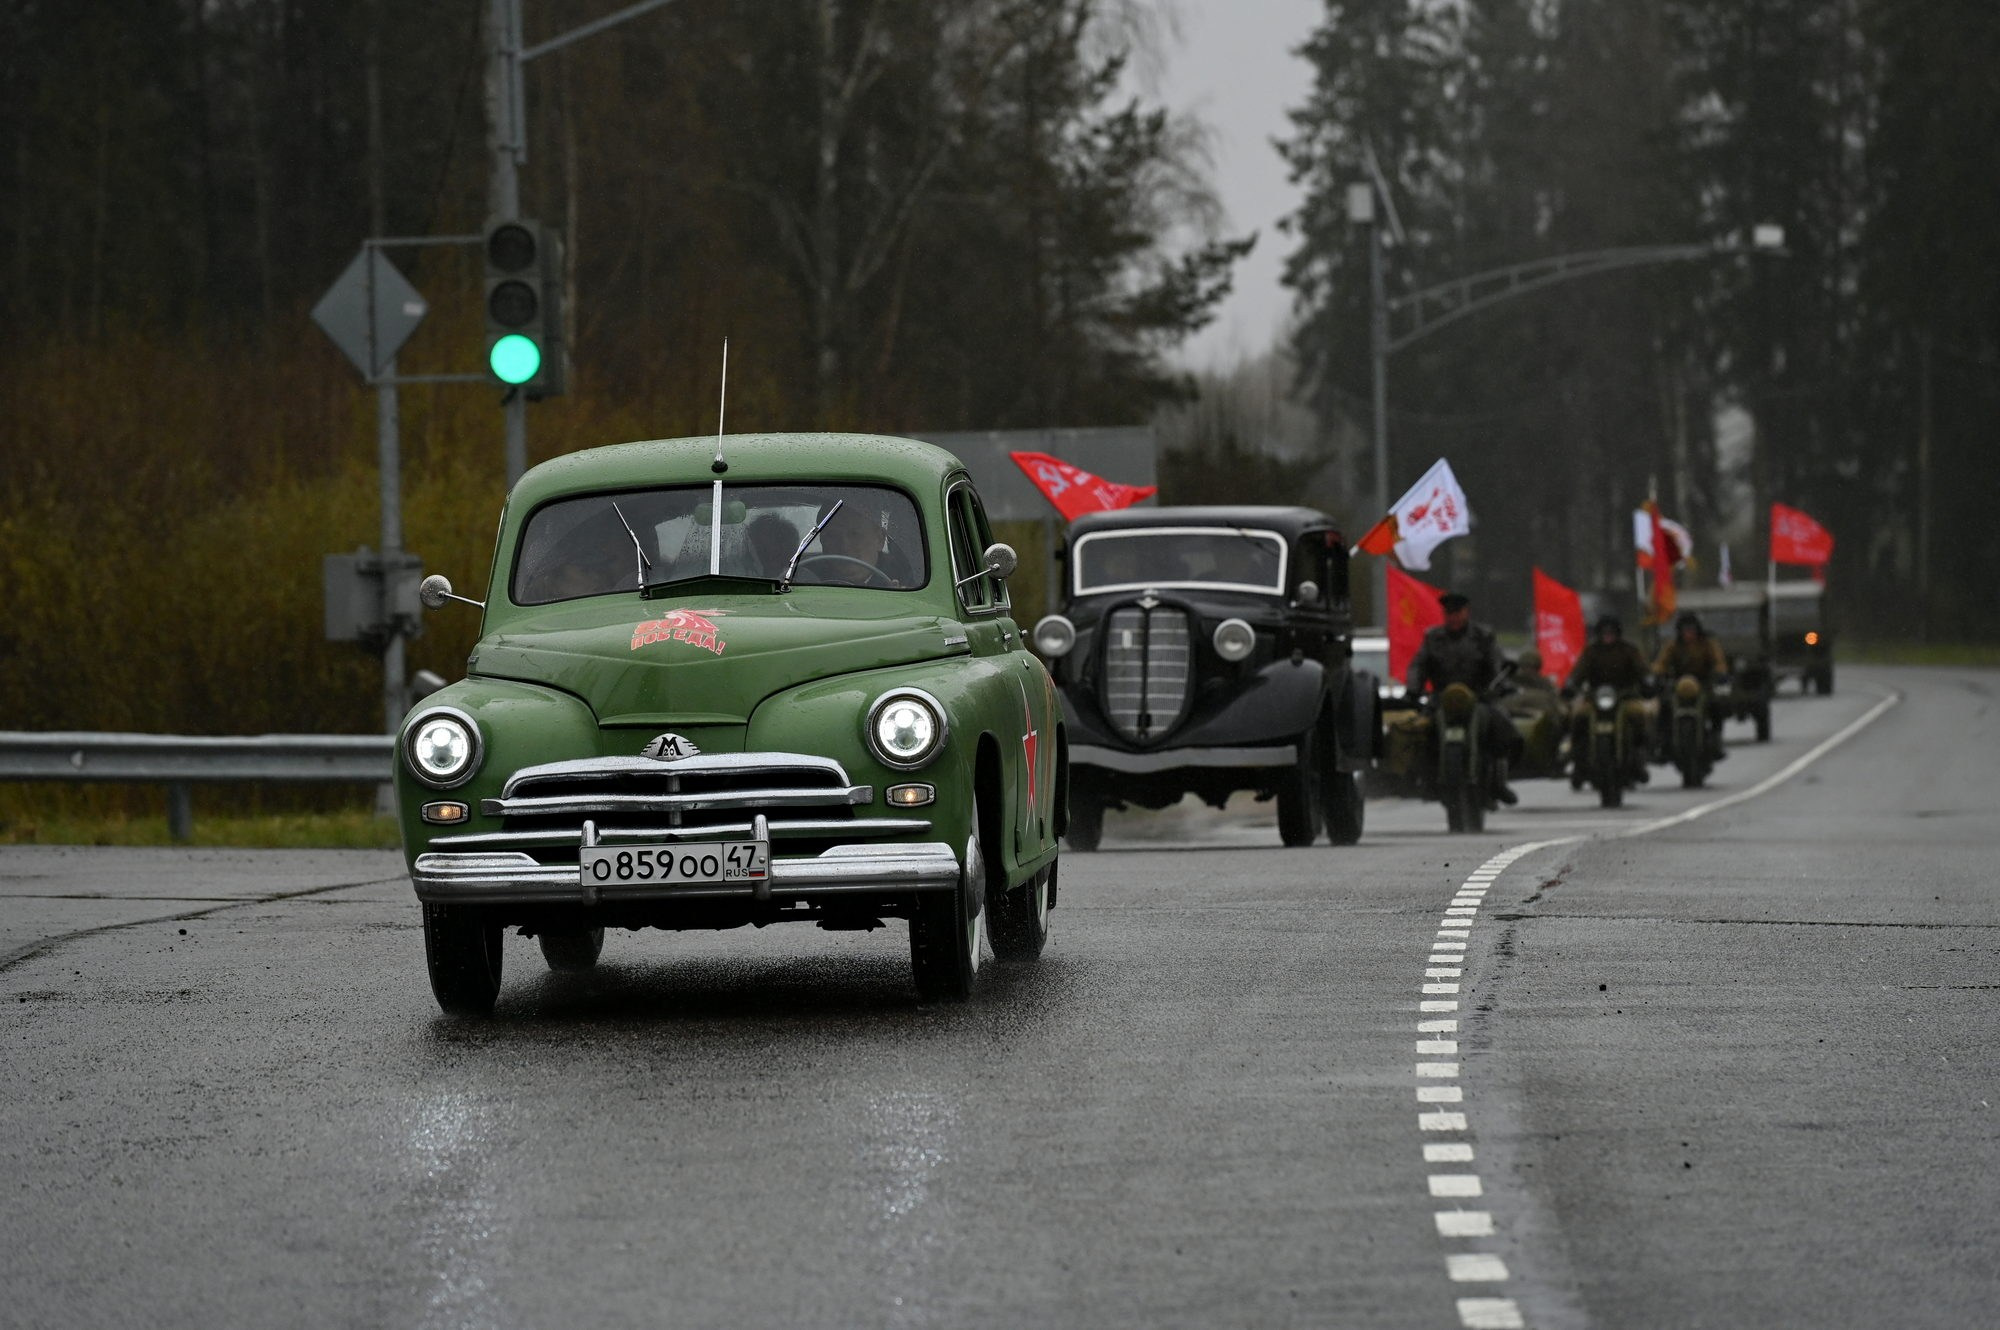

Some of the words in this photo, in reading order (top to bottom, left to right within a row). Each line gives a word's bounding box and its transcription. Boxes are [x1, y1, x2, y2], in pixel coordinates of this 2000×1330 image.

[631, 629, 726, 656] ПОБЕДА!
[656, 736, 683, 756] М
[663, 748, 675, 756] 20
[727, 845, 757, 868] 47
[725, 868, 748, 877] RUS
